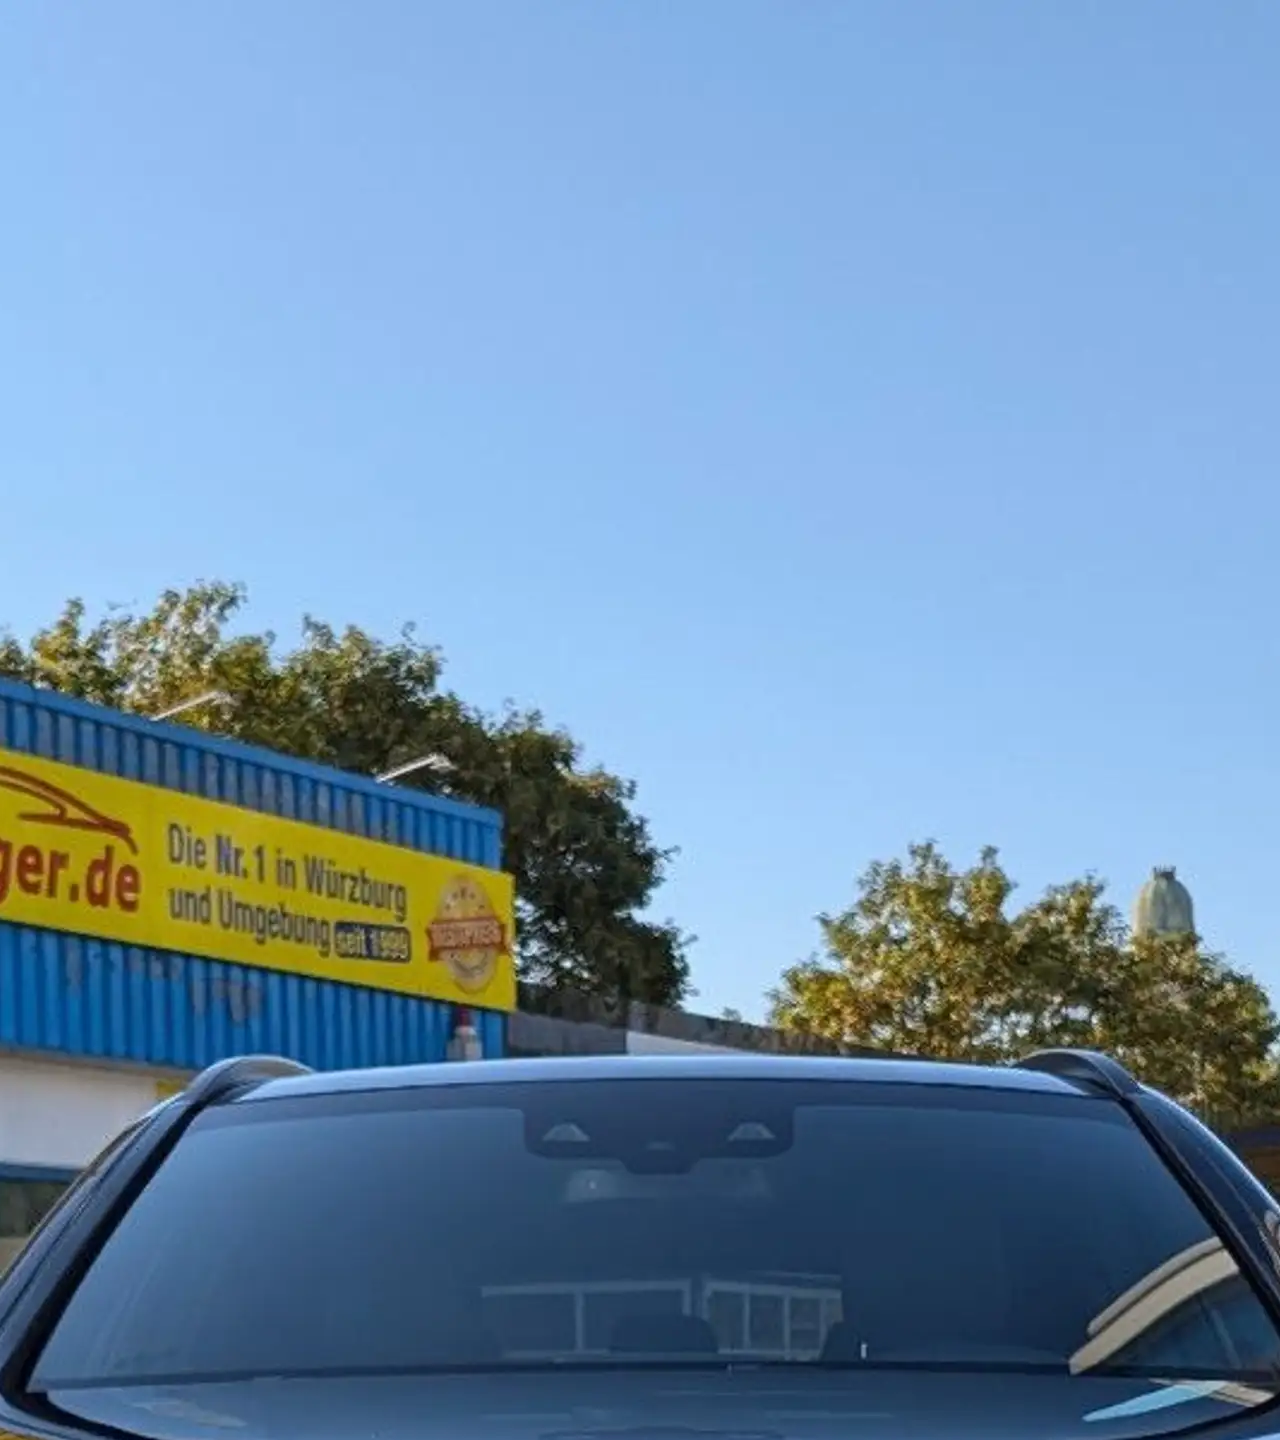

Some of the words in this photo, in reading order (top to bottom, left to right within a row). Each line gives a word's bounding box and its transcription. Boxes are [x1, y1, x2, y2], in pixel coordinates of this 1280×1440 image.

[169, 823, 207, 868] Die
[216, 835, 249, 879] Nr.
[255, 845, 265, 882] 1
[276, 849, 297, 891] in
[304, 855, 408, 922] Würzburg
[169, 886, 212, 925] und
[220, 891, 331, 957] Umgebung
[336, 928, 366, 957] seit
